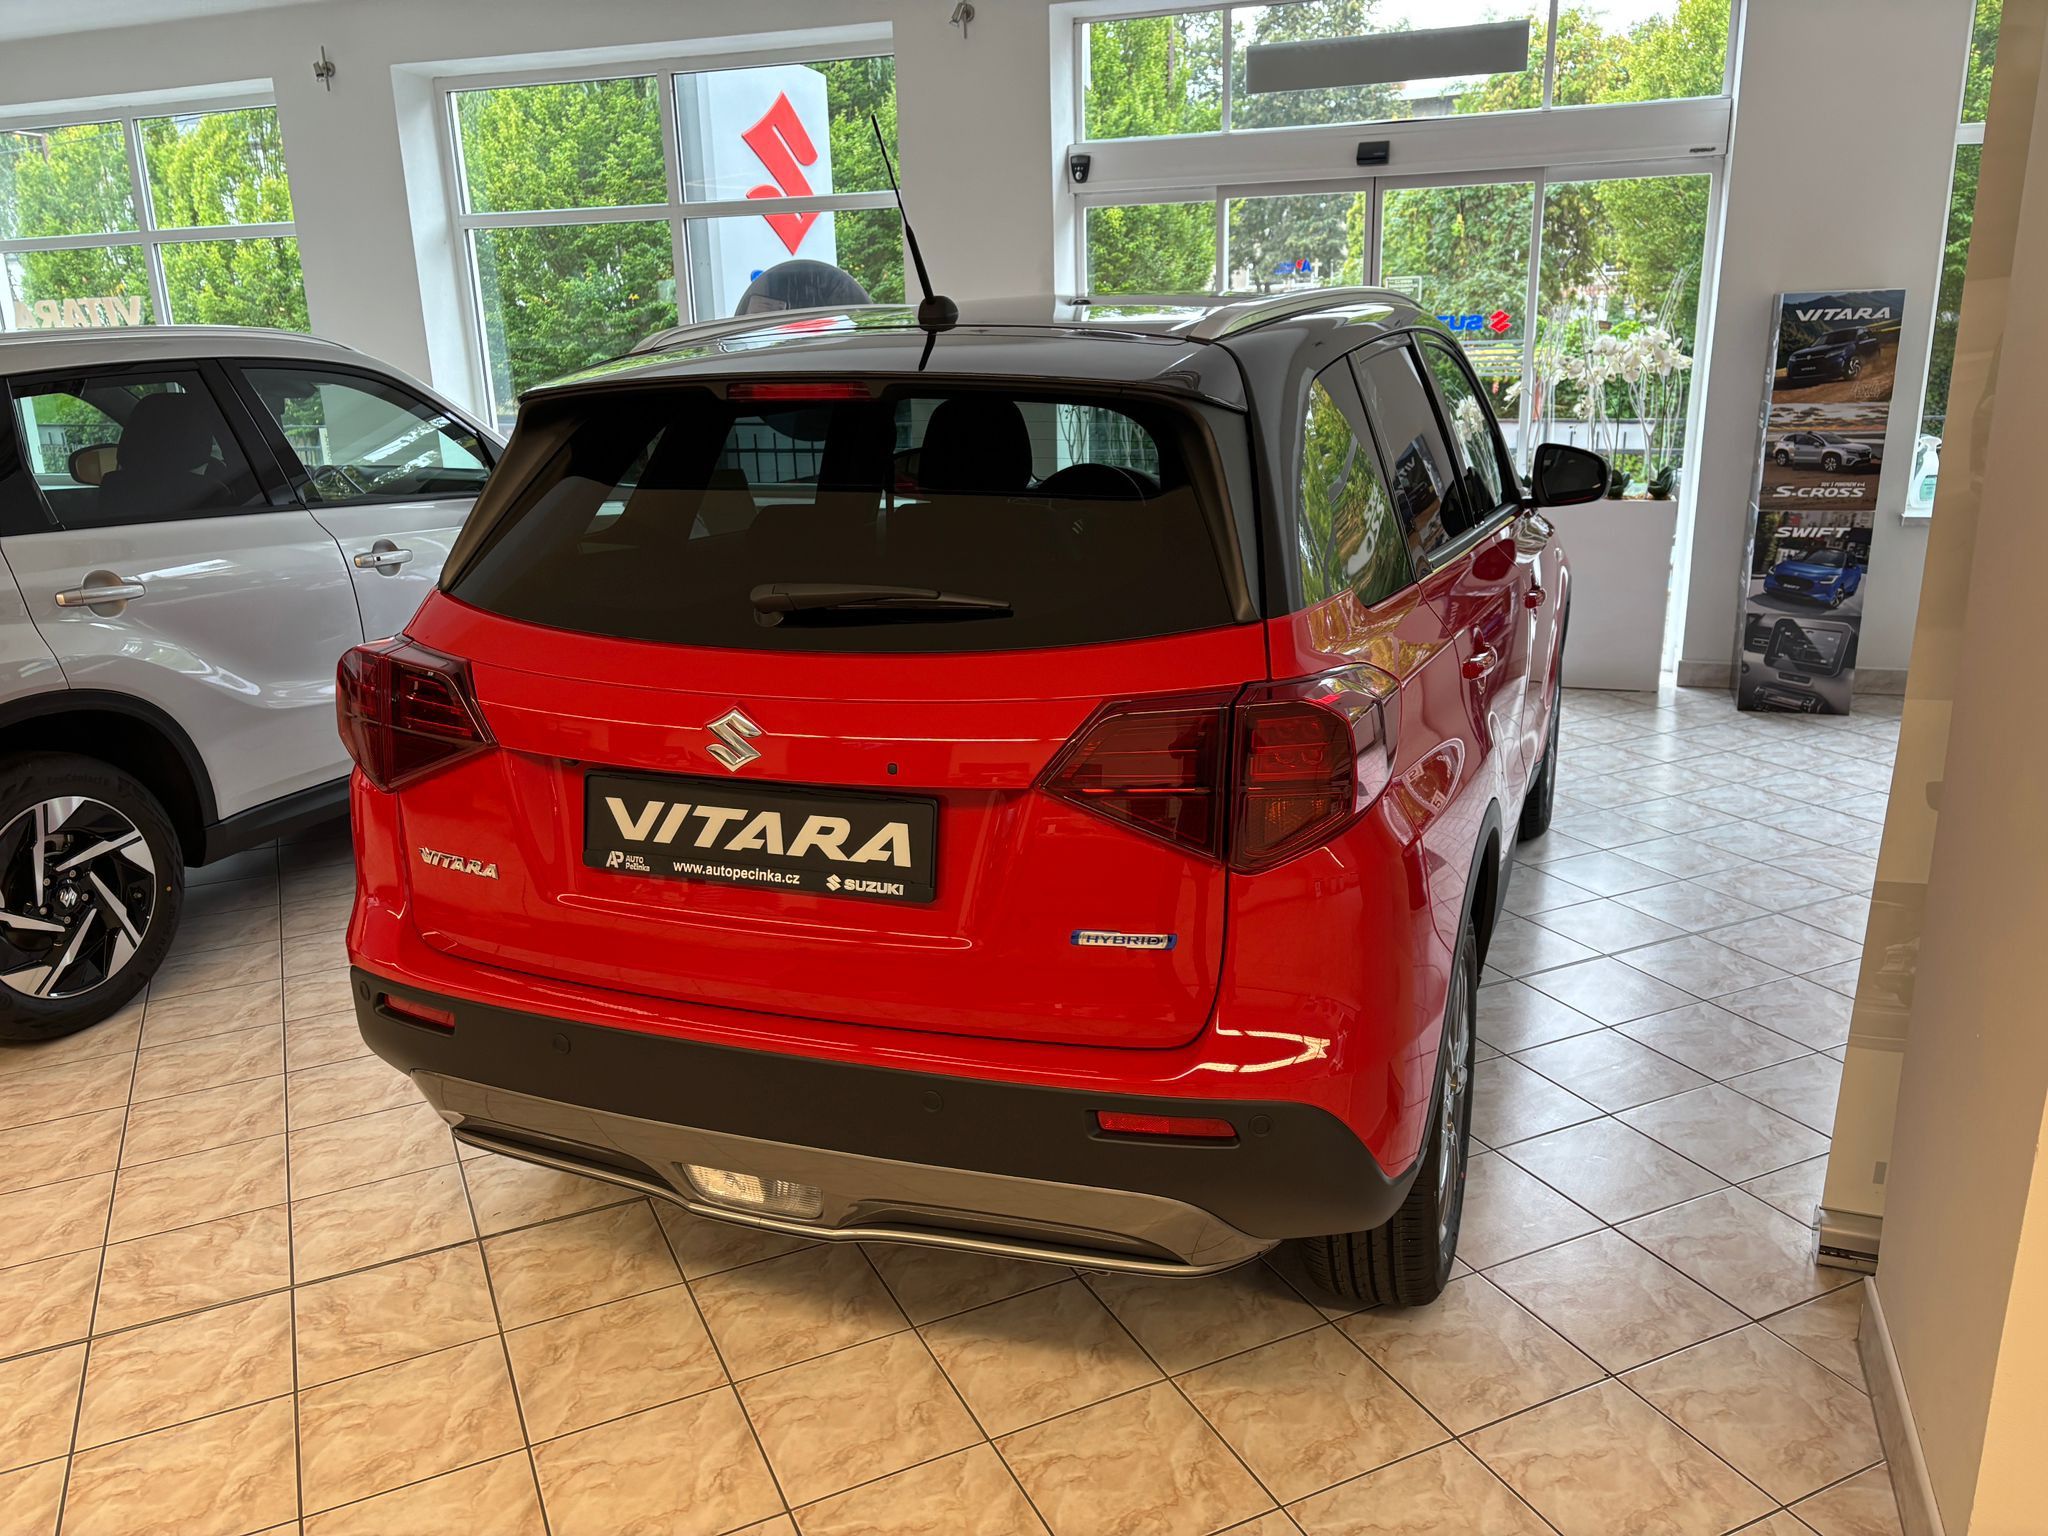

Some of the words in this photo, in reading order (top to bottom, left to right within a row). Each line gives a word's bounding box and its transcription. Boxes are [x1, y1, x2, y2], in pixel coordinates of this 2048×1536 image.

[1796, 307, 1890, 322] VITARA
[1772, 485, 1866, 498] S-CROSS
[1774, 527, 1851, 538] SWIFT
[605, 796, 911, 867] VITARA
[419, 847, 498, 880] VITARA
[625, 855, 644, 863] AUTO
[673, 861, 800, 885] www.autopecinka.cz
[844, 878, 904, 896] SUZUKI
[1086, 934, 1161, 946] HYBRID
